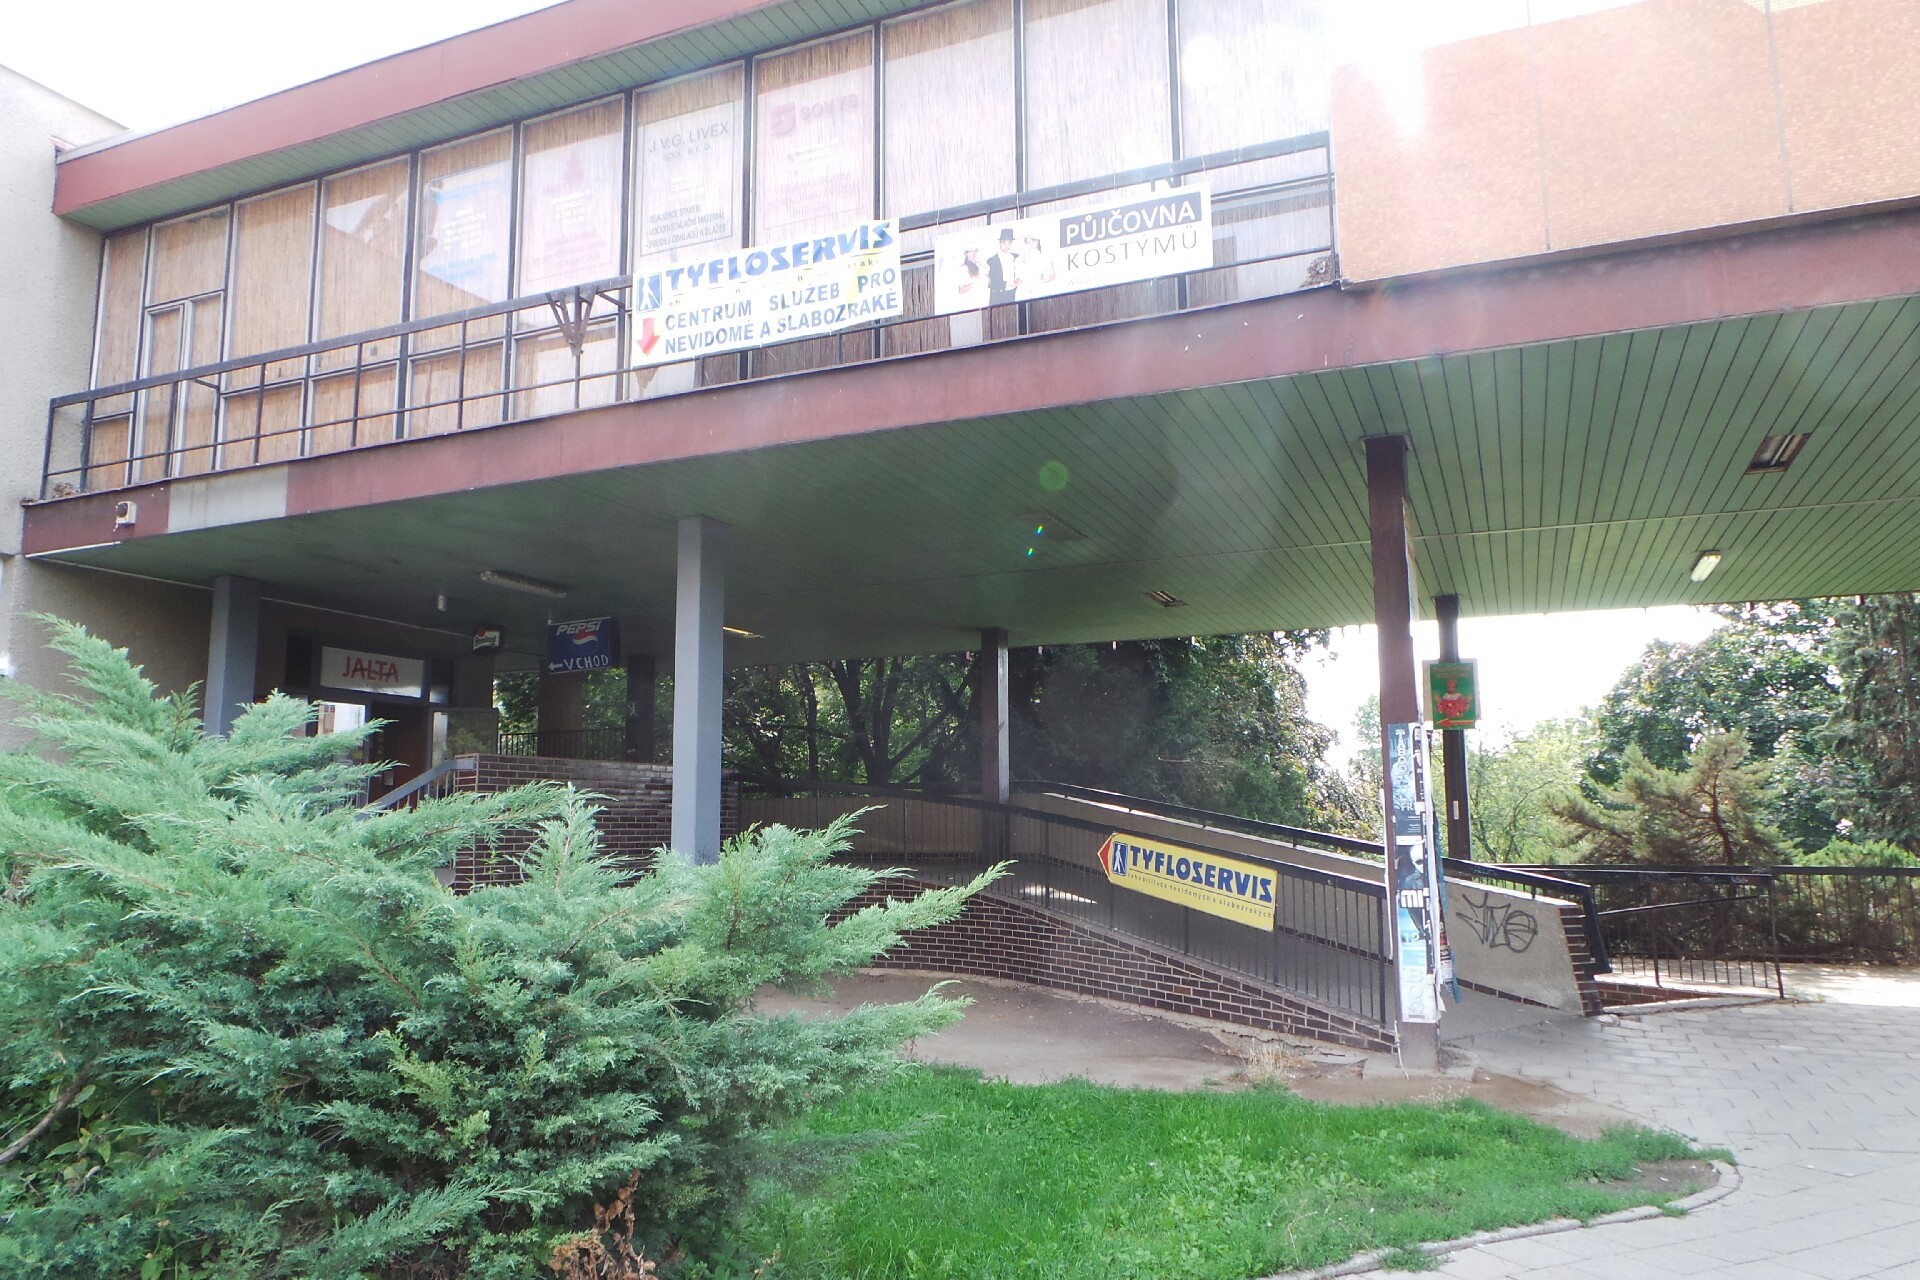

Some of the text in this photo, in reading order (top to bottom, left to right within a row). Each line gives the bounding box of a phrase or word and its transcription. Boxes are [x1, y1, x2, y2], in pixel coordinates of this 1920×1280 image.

[689, 122, 729, 142] LIVEX
[1066, 201, 1195, 245] PŮJČOVNA
[666, 222, 894, 291] TYFLOSERVIS
[665, 300, 751, 331] CENTRUM
[769, 280, 840, 312] SLUŽEB
[858, 268, 896, 293] PRO
[665, 288, 898, 355] NEVIDOMÉ A SLABOZRAKÉ
[556, 621, 602, 636] PEPSI
[342, 655, 400, 683] JALTA
[563, 655, 608, 670] VCHOD
[1130, 846, 1273, 903] TYFLOSERVIS
